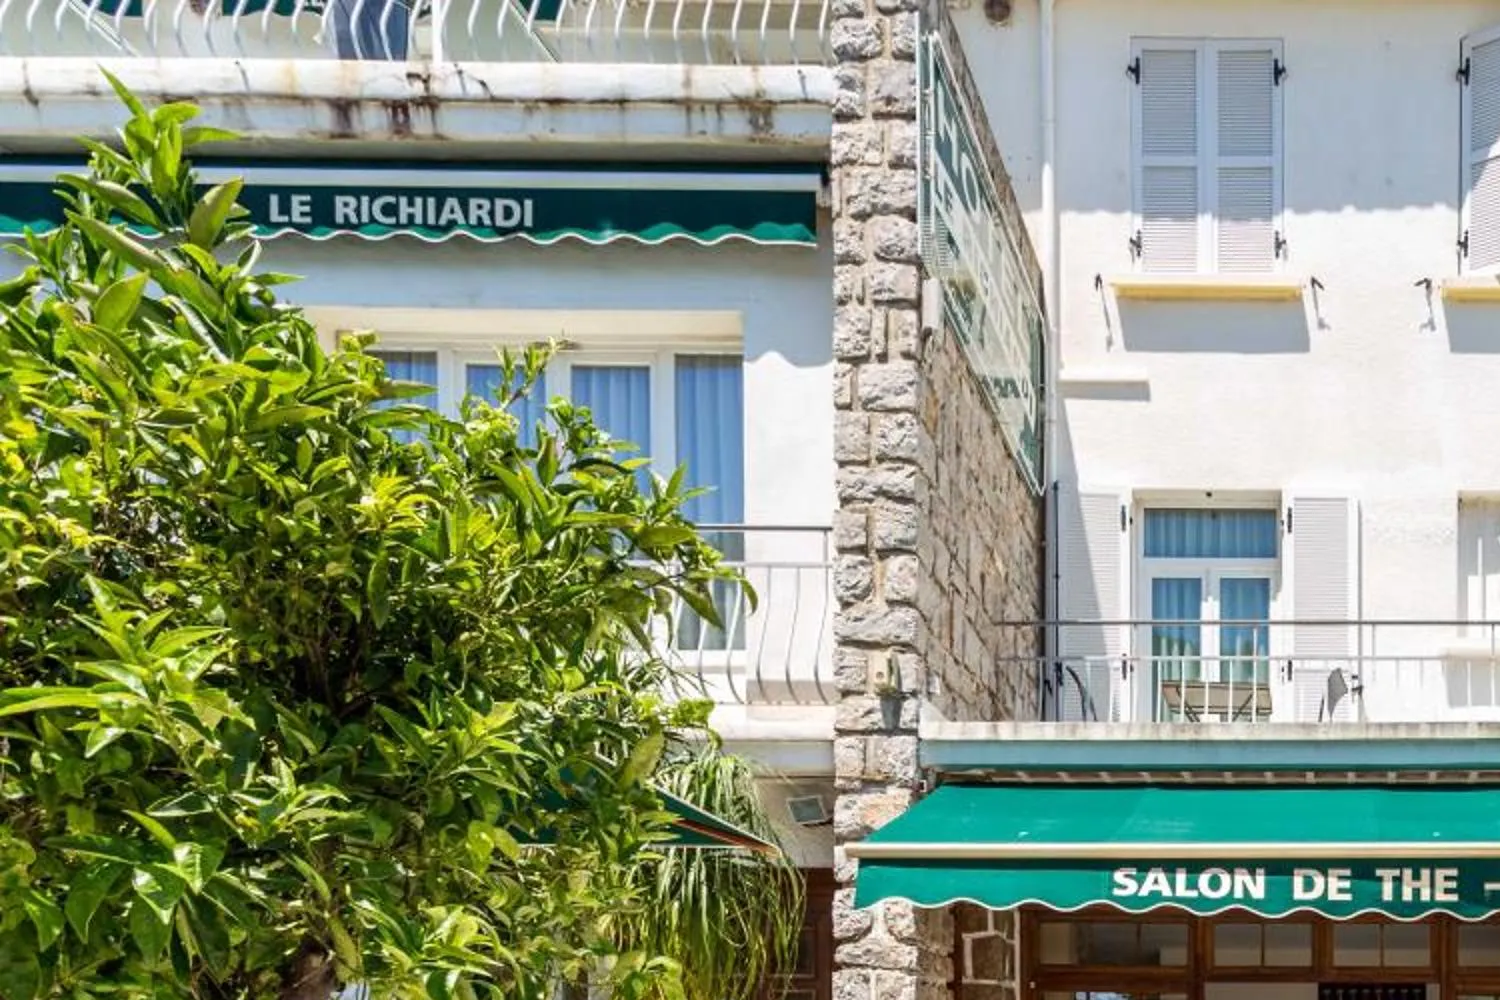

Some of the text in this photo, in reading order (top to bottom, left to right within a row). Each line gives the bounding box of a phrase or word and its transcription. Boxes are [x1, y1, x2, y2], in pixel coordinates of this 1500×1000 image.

[269, 193, 534, 228] LE RICHIARDI
[1112, 867, 1265, 899] SALON
[1293, 868, 1352, 900] DE
[1376, 868, 1458, 901] THE
